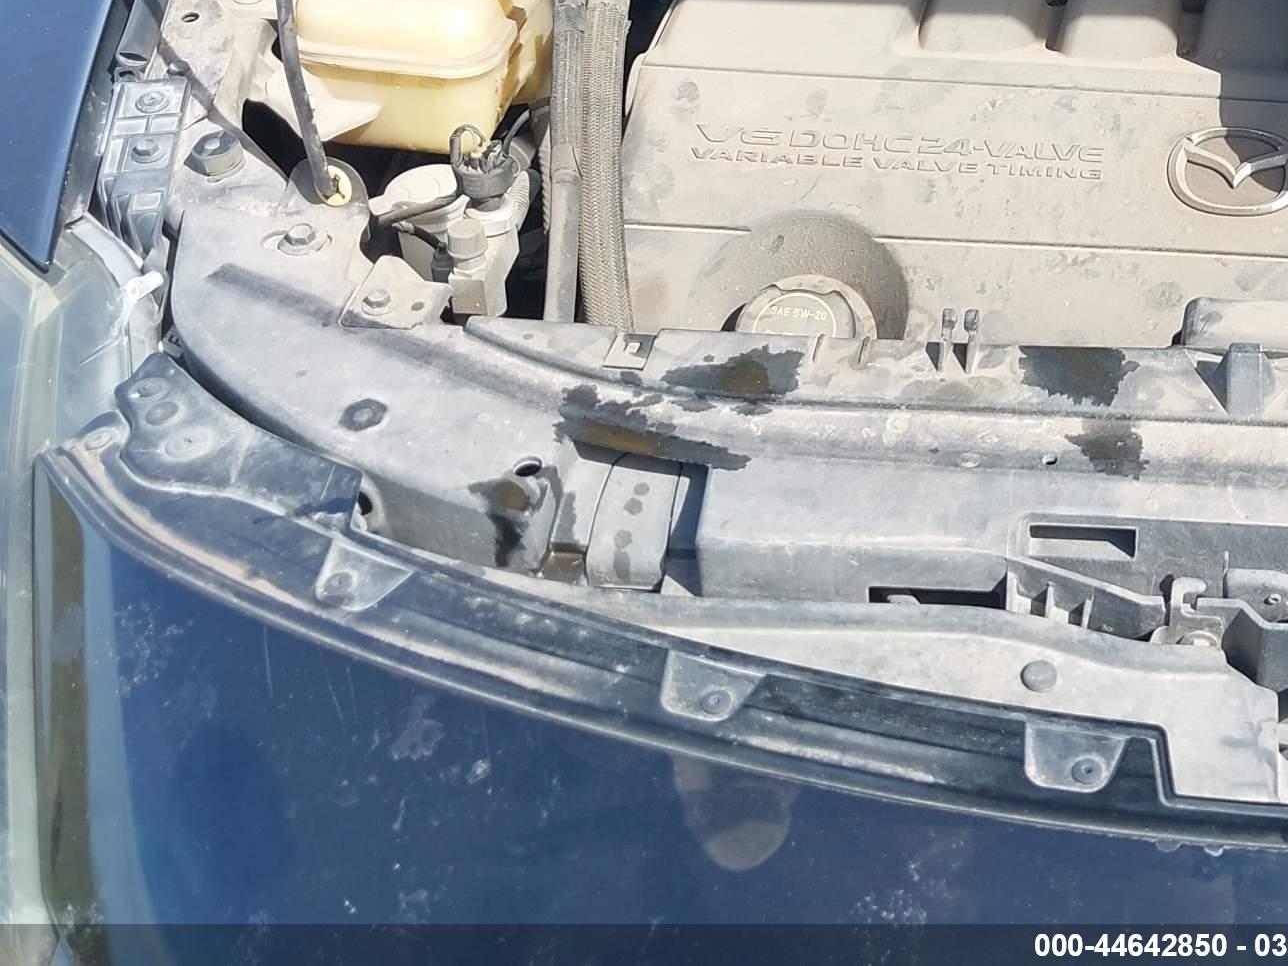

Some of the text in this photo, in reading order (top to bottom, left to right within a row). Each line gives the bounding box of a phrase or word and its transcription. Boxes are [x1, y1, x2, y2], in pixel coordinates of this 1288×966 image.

[695, 122, 1105, 164] V6 DOHC 24-VALVE
[690, 146, 1102, 181] VARIABLE VALVE TIMING
[770, 305, 828, 321] SAE 5W-20
